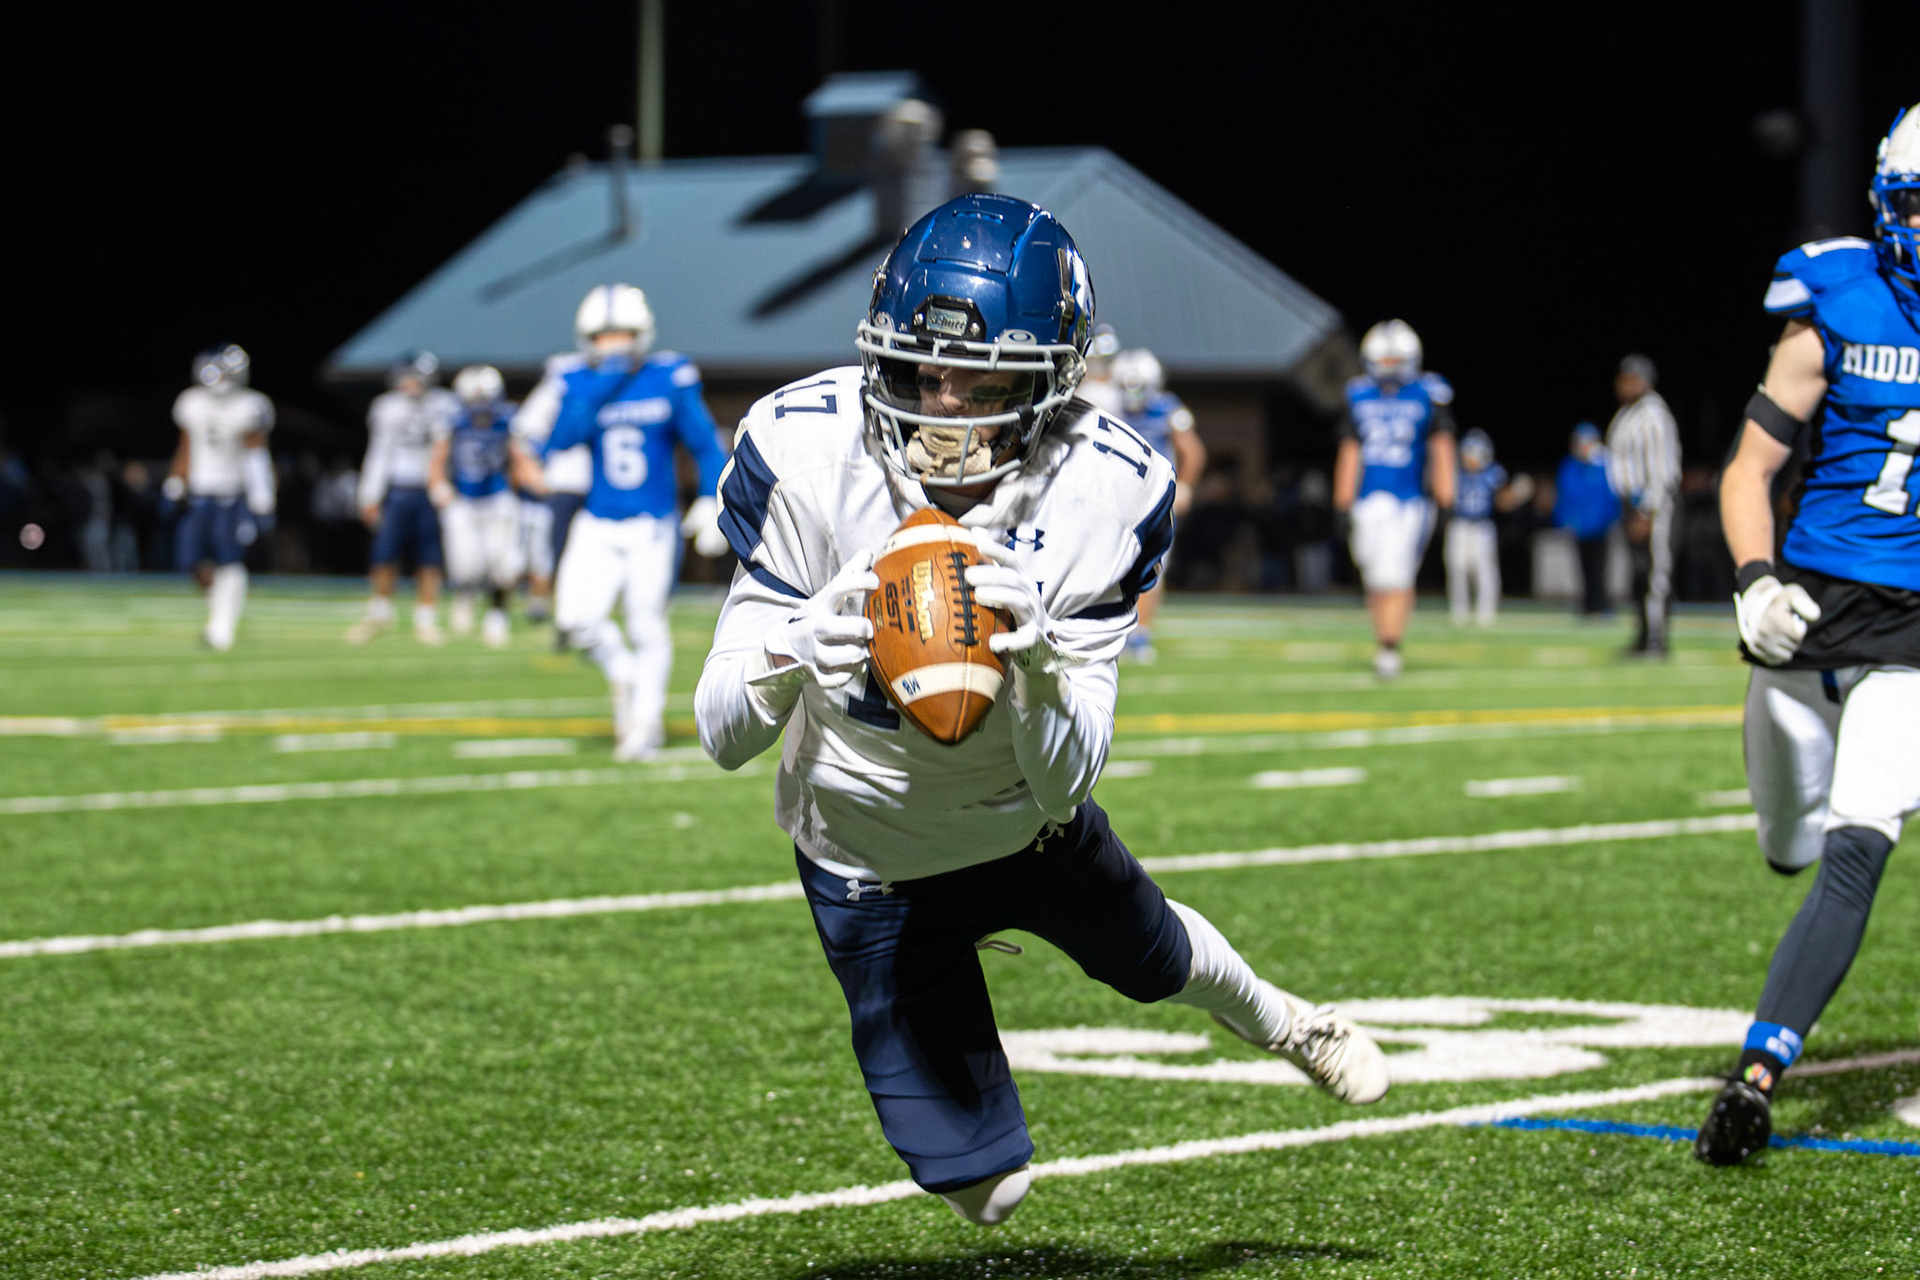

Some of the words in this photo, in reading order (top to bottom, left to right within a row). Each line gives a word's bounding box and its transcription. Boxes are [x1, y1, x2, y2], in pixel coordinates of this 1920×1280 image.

[1842, 342, 1920, 384] MIDD
[774, 379, 838, 419] 17
[601, 425, 649, 492] 6
[1092, 415, 1152, 480] 17
[885, 581, 904, 635] GST
[911, 557, 936, 645] Wilson
